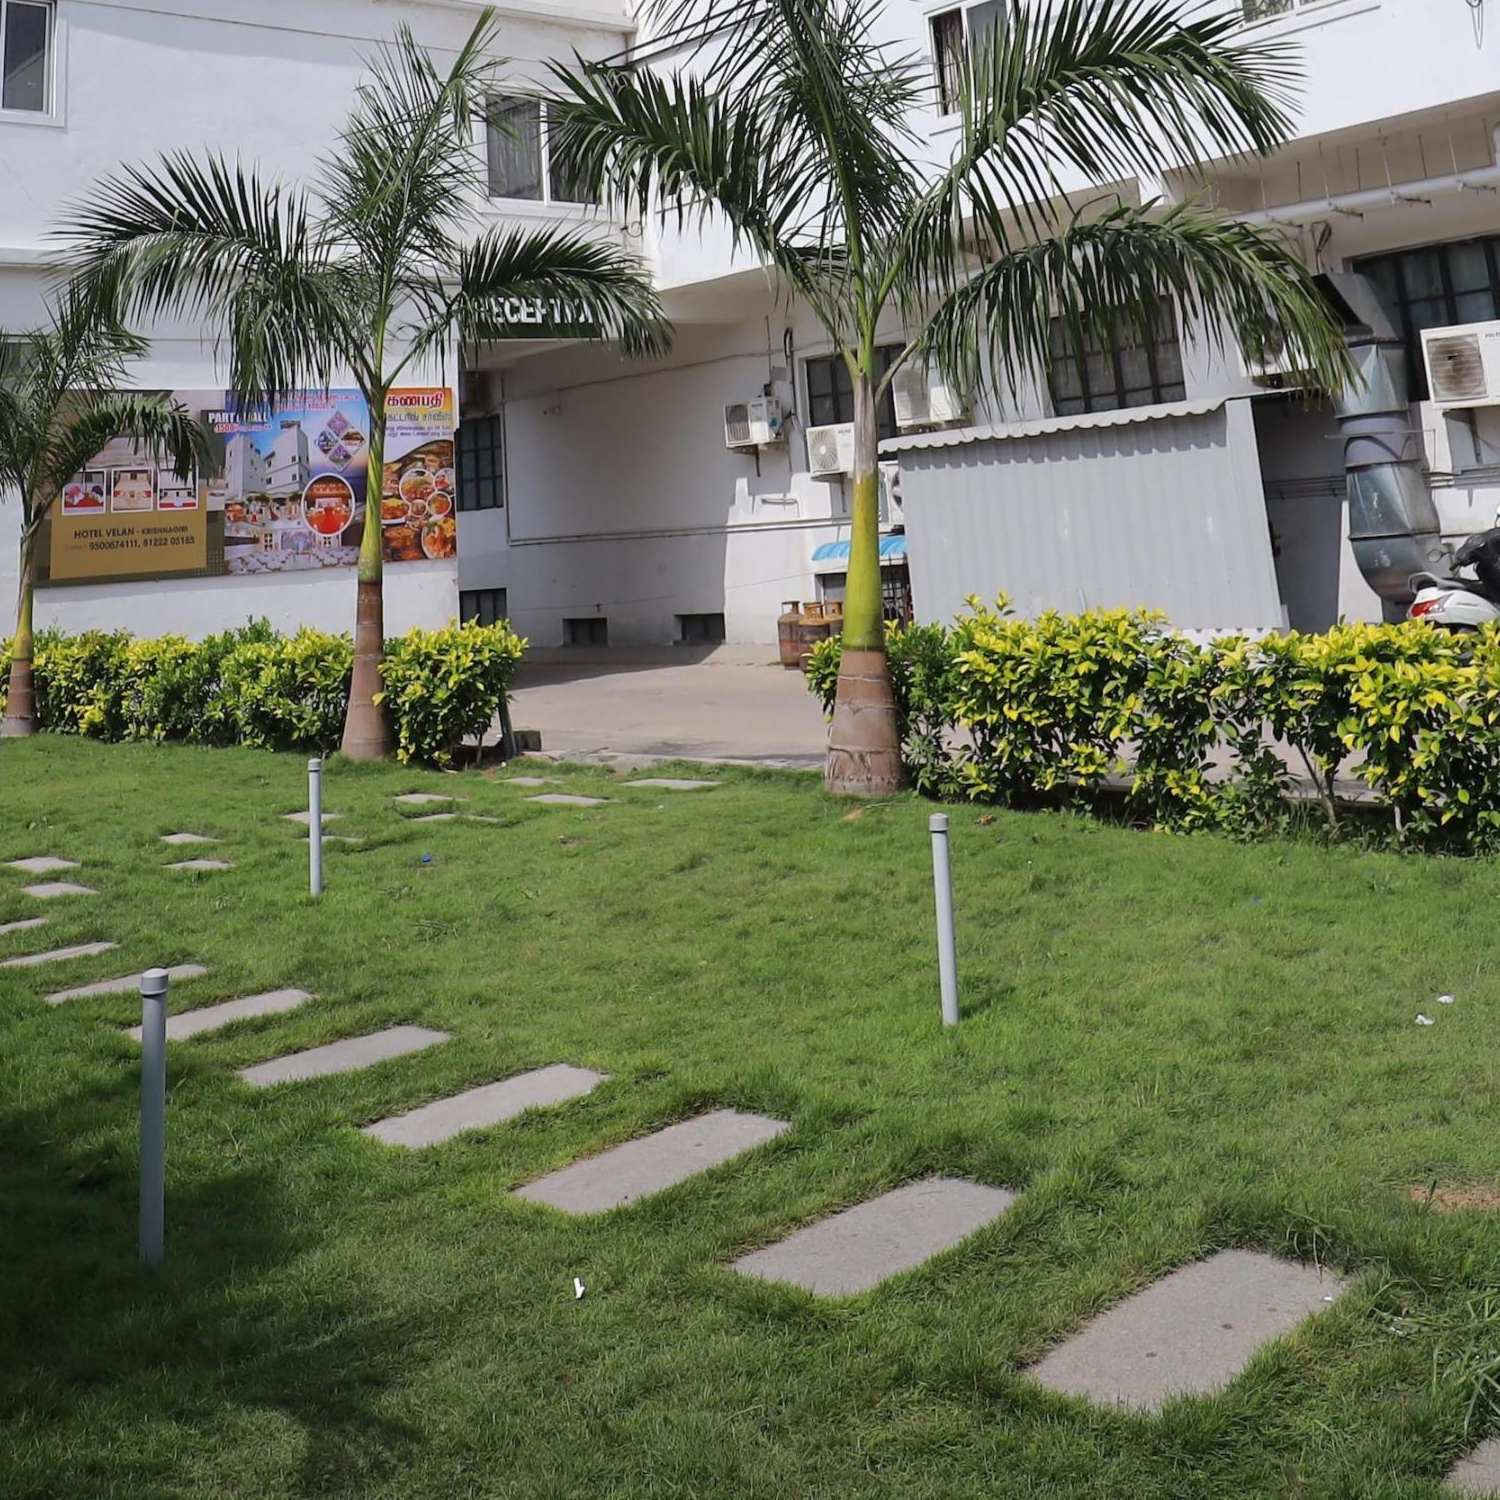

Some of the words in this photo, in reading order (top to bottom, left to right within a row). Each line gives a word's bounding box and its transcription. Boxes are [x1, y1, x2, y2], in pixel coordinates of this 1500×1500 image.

[74, 529, 103, 539] HOTEL
[106, 527, 134, 537] VELAN
[141, 525, 188, 535] KRISHNAGIRI
